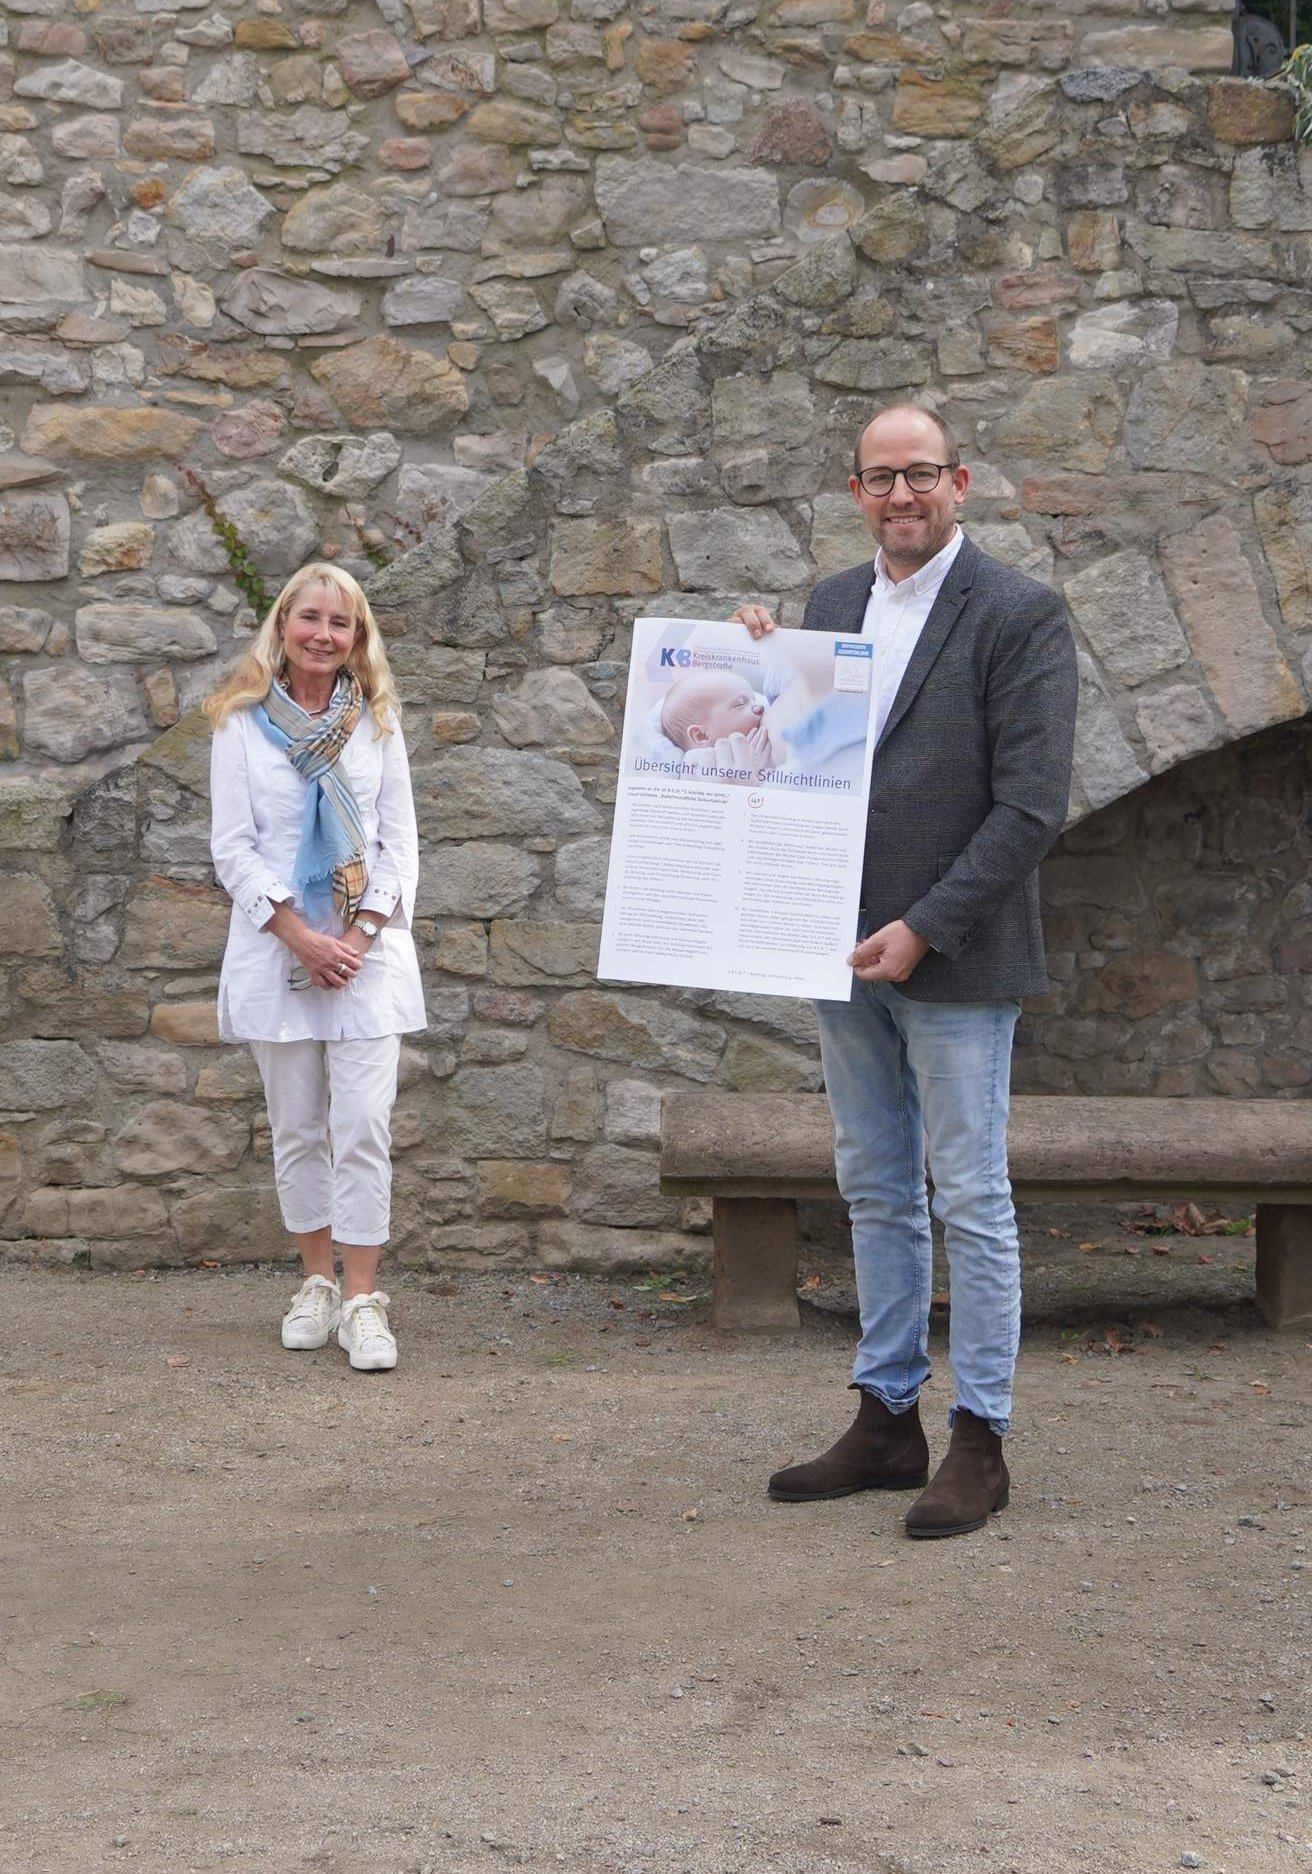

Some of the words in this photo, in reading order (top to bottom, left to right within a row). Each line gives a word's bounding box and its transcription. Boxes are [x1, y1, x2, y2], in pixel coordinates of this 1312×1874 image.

[693, 652, 760, 665] Kreiskrankenhaus
[634, 757, 696, 775] Übersicht
[701, 766, 753, 780] unserer
[758, 769, 851, 790] Stillrichtlinien
